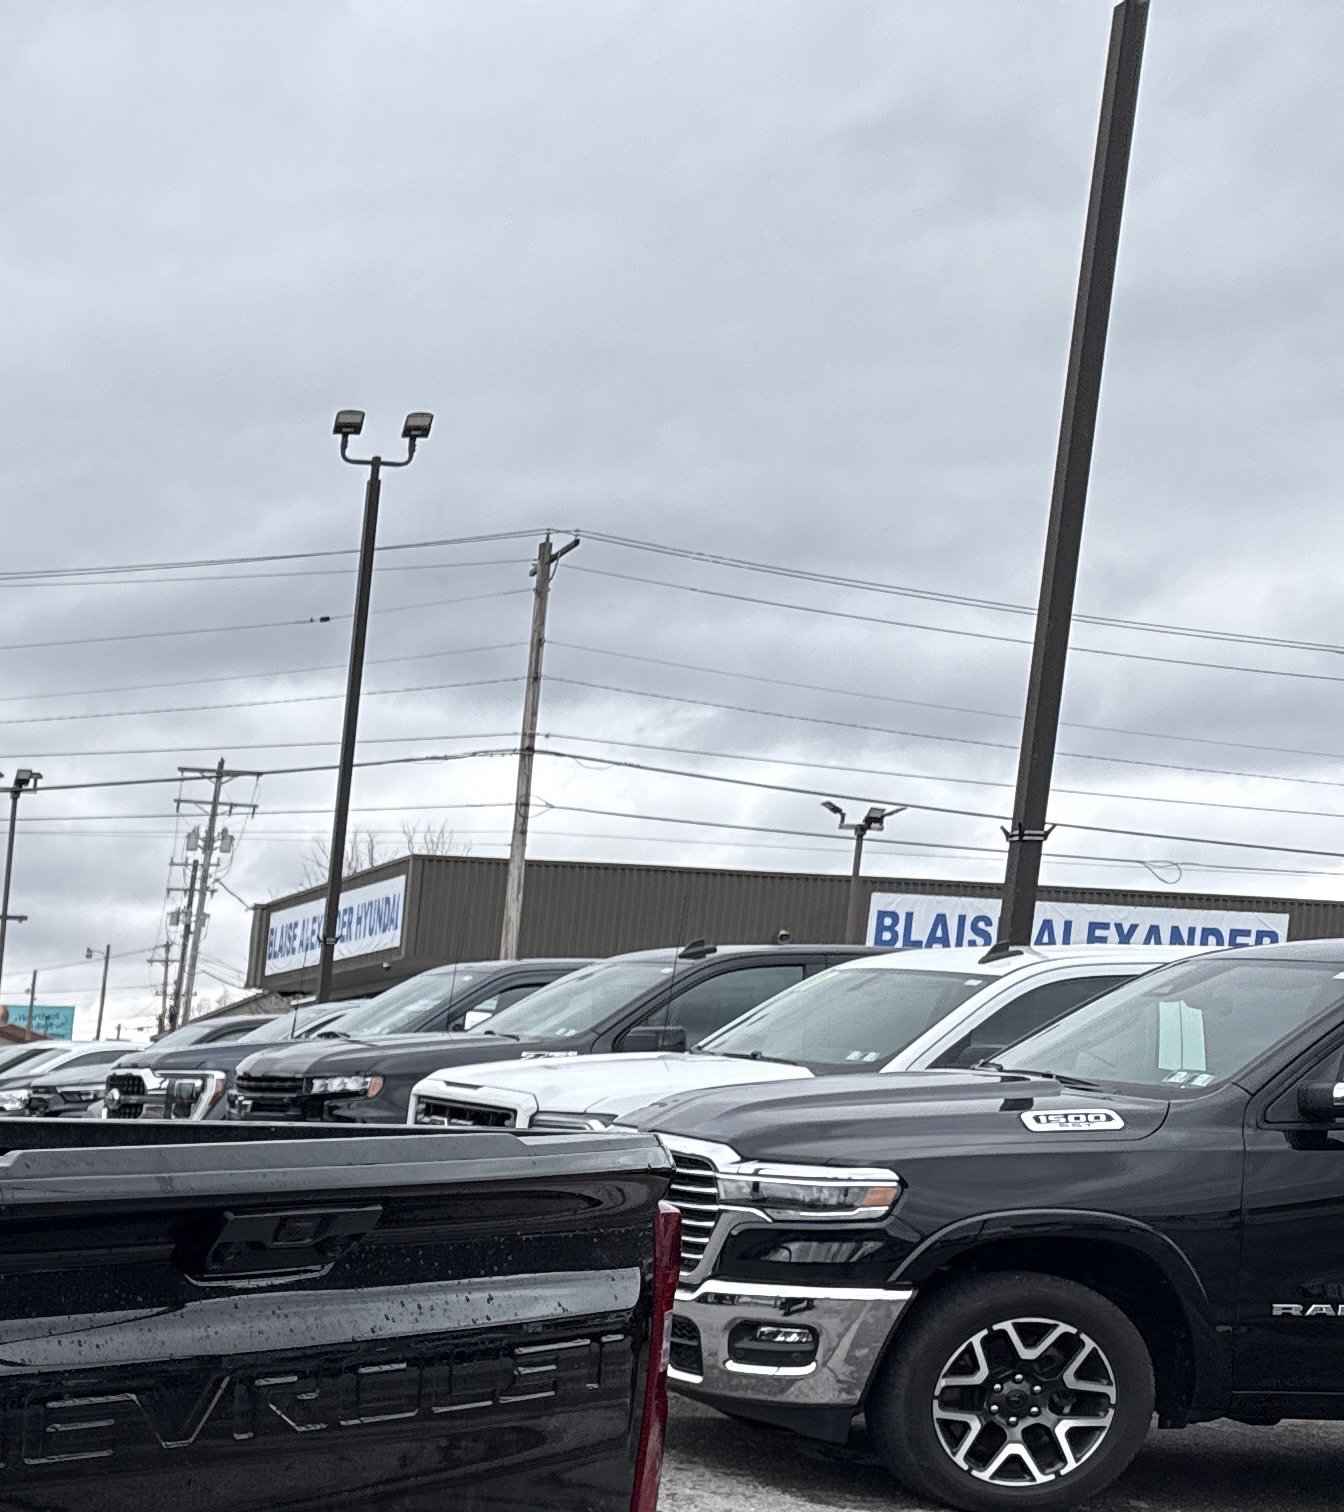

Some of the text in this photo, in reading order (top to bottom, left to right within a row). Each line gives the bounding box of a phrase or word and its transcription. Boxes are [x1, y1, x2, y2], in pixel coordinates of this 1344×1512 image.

[268, 893, 401, 960] BLAISE ALEXDER HYUNDAI
[873, 910, 994, 948] BLAIS
[1037, 1113, 1107, 1124] 1500
